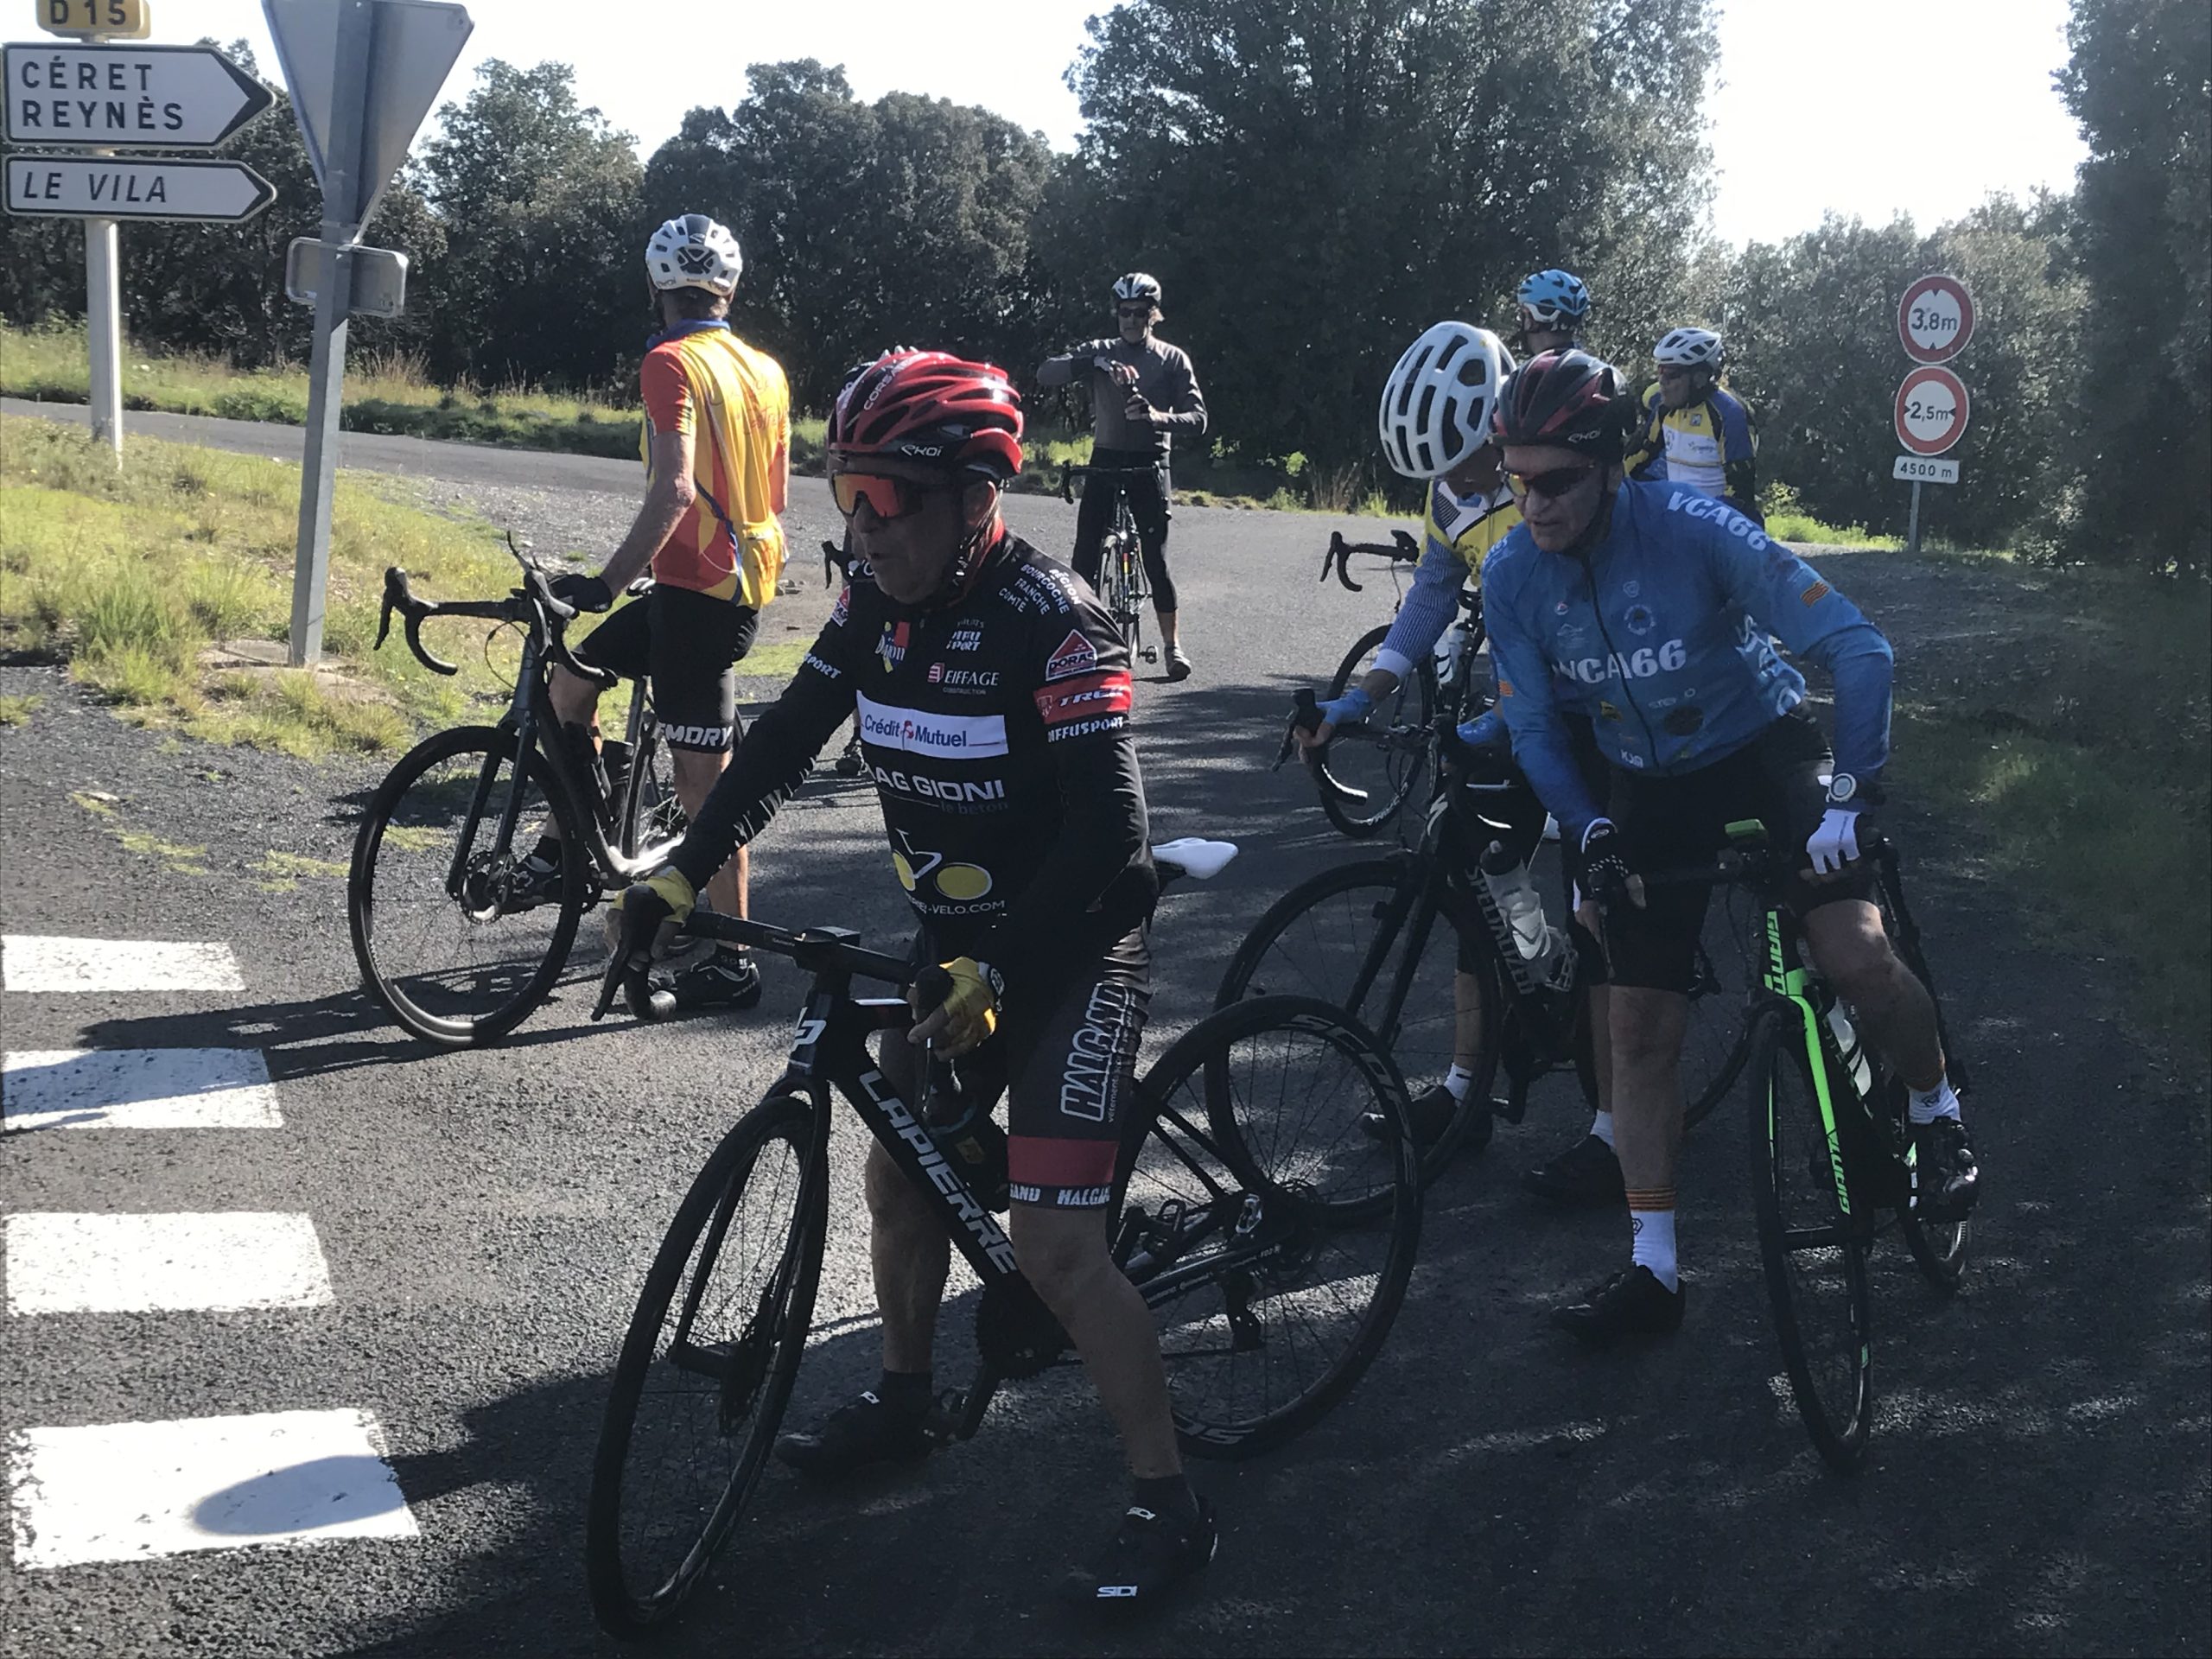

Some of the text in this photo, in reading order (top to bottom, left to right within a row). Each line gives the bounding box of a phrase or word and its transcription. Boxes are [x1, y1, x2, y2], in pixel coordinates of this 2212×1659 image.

[49, 0, 126, 25] D 15
[22, 55, 152, 91] CÉRET
[22, 96, 184, 131] REYNÈS
[23, 172, 168, 204] LE VILA
[1900, 461, 1953, 478] 4500 m
[1667, 491, 1771, 551] VCA66
[1014, 577, 1052, 615] FRANCHE
[1020, 564, 1070, 614] BOURGOGNE
[944, 670, 1000, 686] EIFFAGE
[1049, 652, 1096, 671] DORAS
[865, 714, 967, 747] Crédit Mutuel
[859, 1069, 1018, 1274] LAPIERRE
